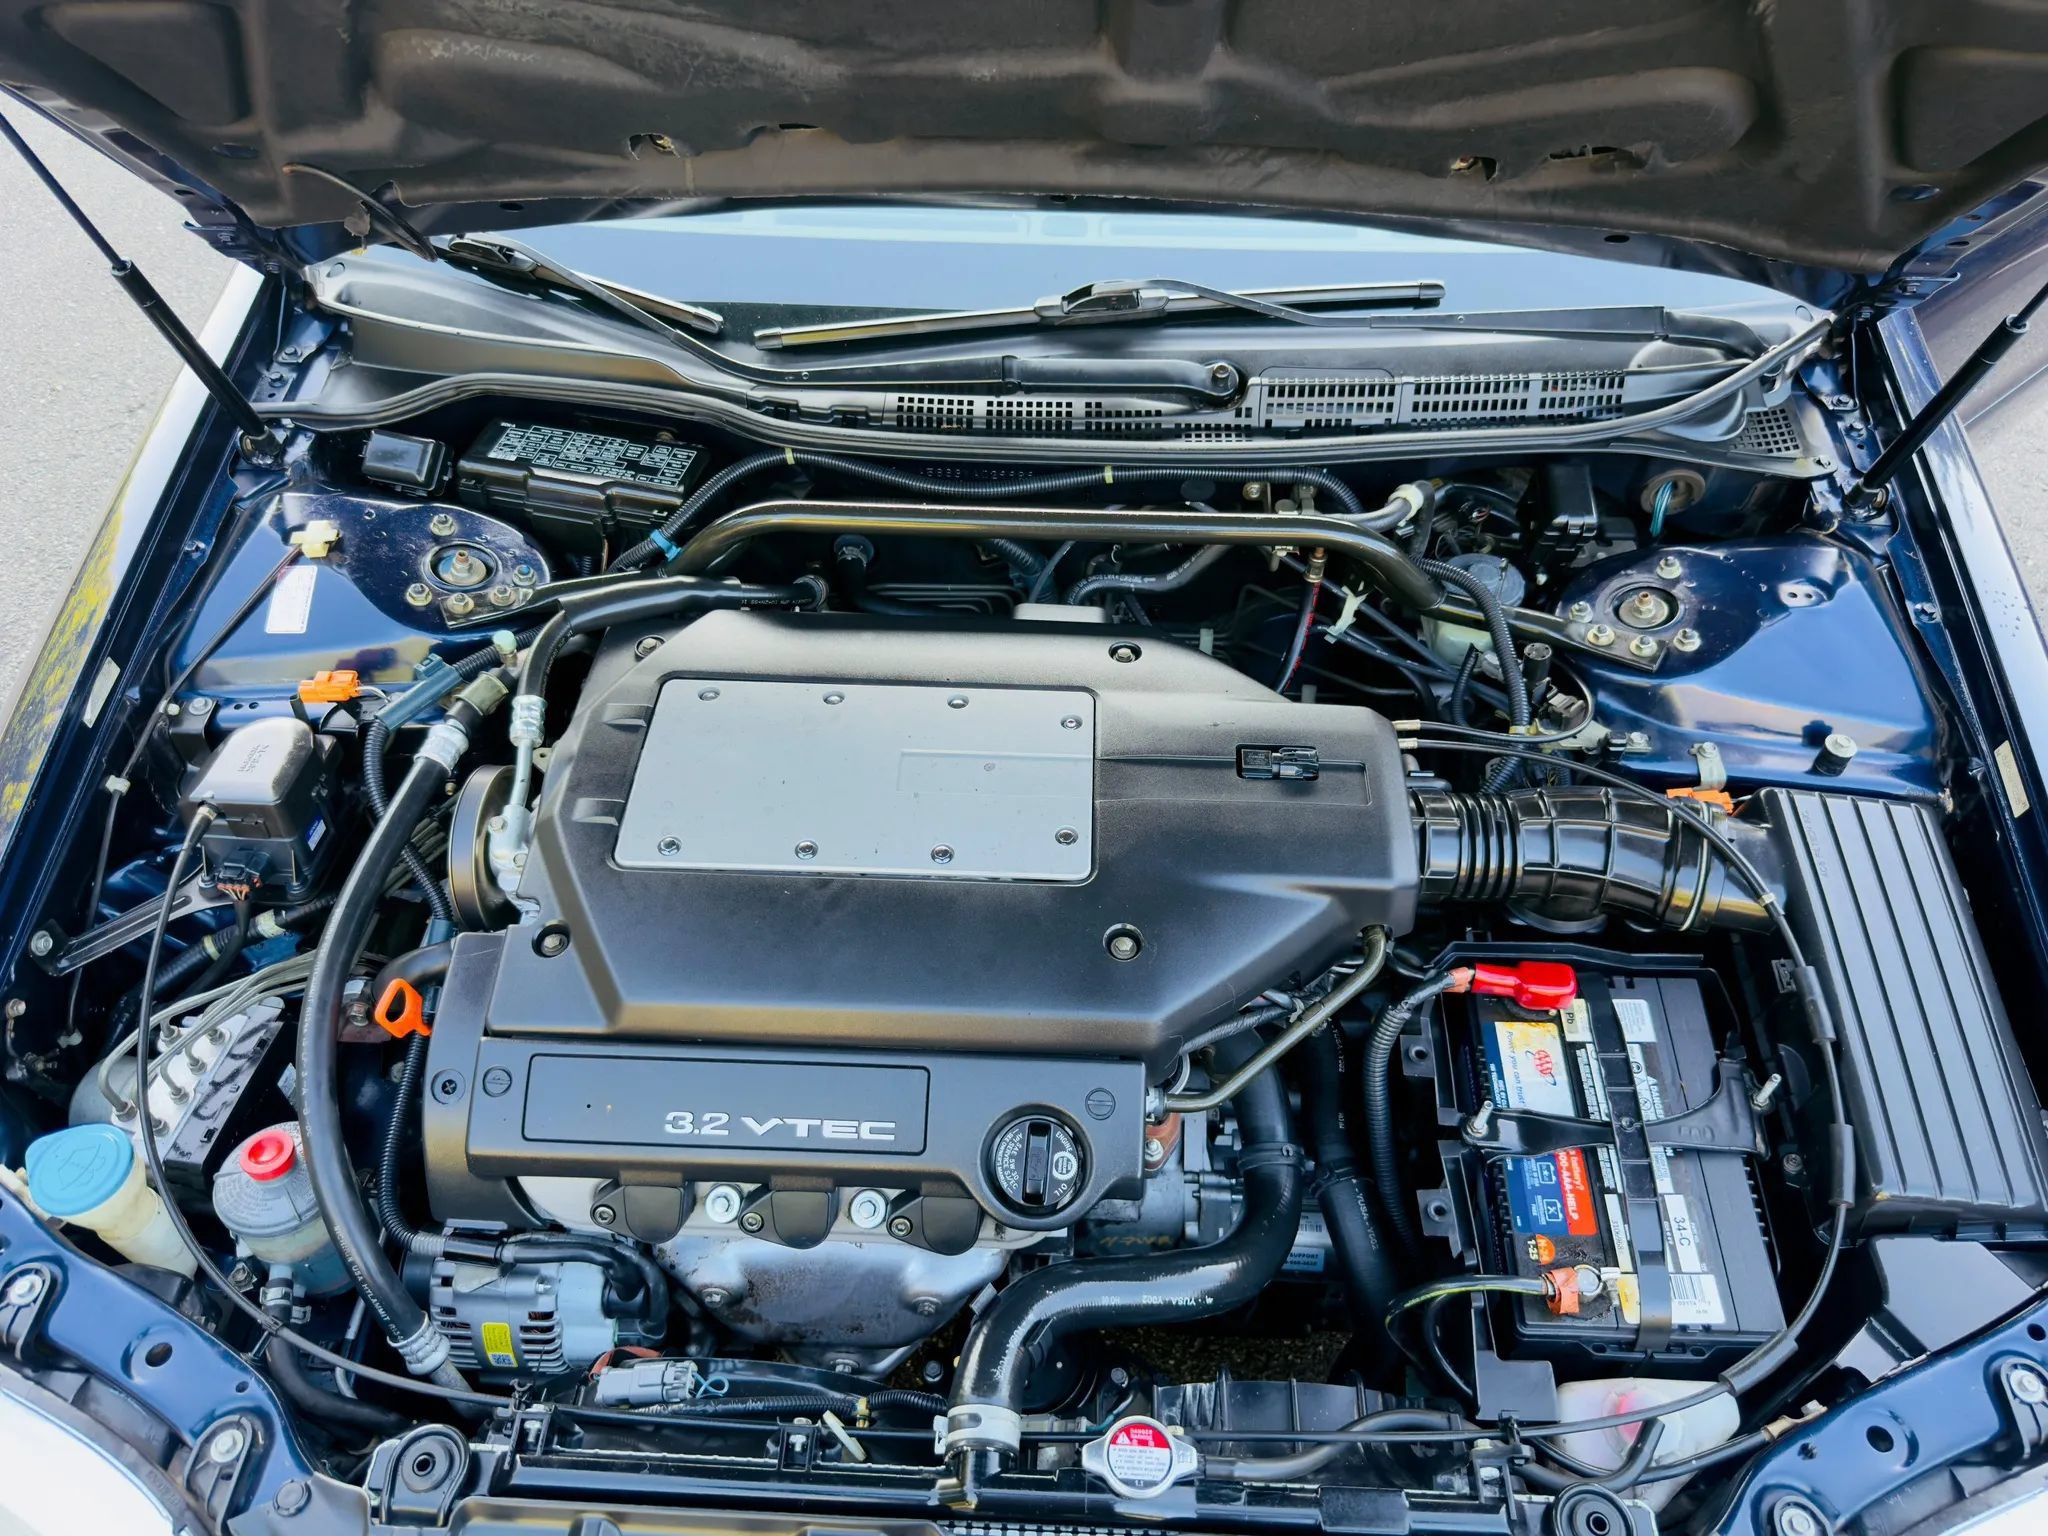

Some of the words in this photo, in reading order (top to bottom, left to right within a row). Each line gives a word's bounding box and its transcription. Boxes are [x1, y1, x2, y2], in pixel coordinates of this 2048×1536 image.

[1565, 1012, 1575, 1025] Pb
[1506, 1031, 1516, 1054] Power
[1509, 1054, 1518, 1071] you
[1513, 1071, 1521, 1086] can
[1516, 1086, 1525, 1104] trust
[664, 1111, 730, 1136] 3.2
[740, 1116, 897, 1141] VTEC
[1013, 1132, 1023, 1143] API
[1055, 1131, 1073, 1153] ENGINE
[1002, 1142, 1016, 1169] SERVICE
[1012, 1142, 1022, 1156] SAE
[1053, 1183, 1068, 1197] OIL
[1674, 1216, 1691, 1247] 34-C
[1527, 1239, 1539, 1261] 1-25
[351, 1265, 364, 1282] USA
[1171, 1296, 1196, 1306] YUSA
